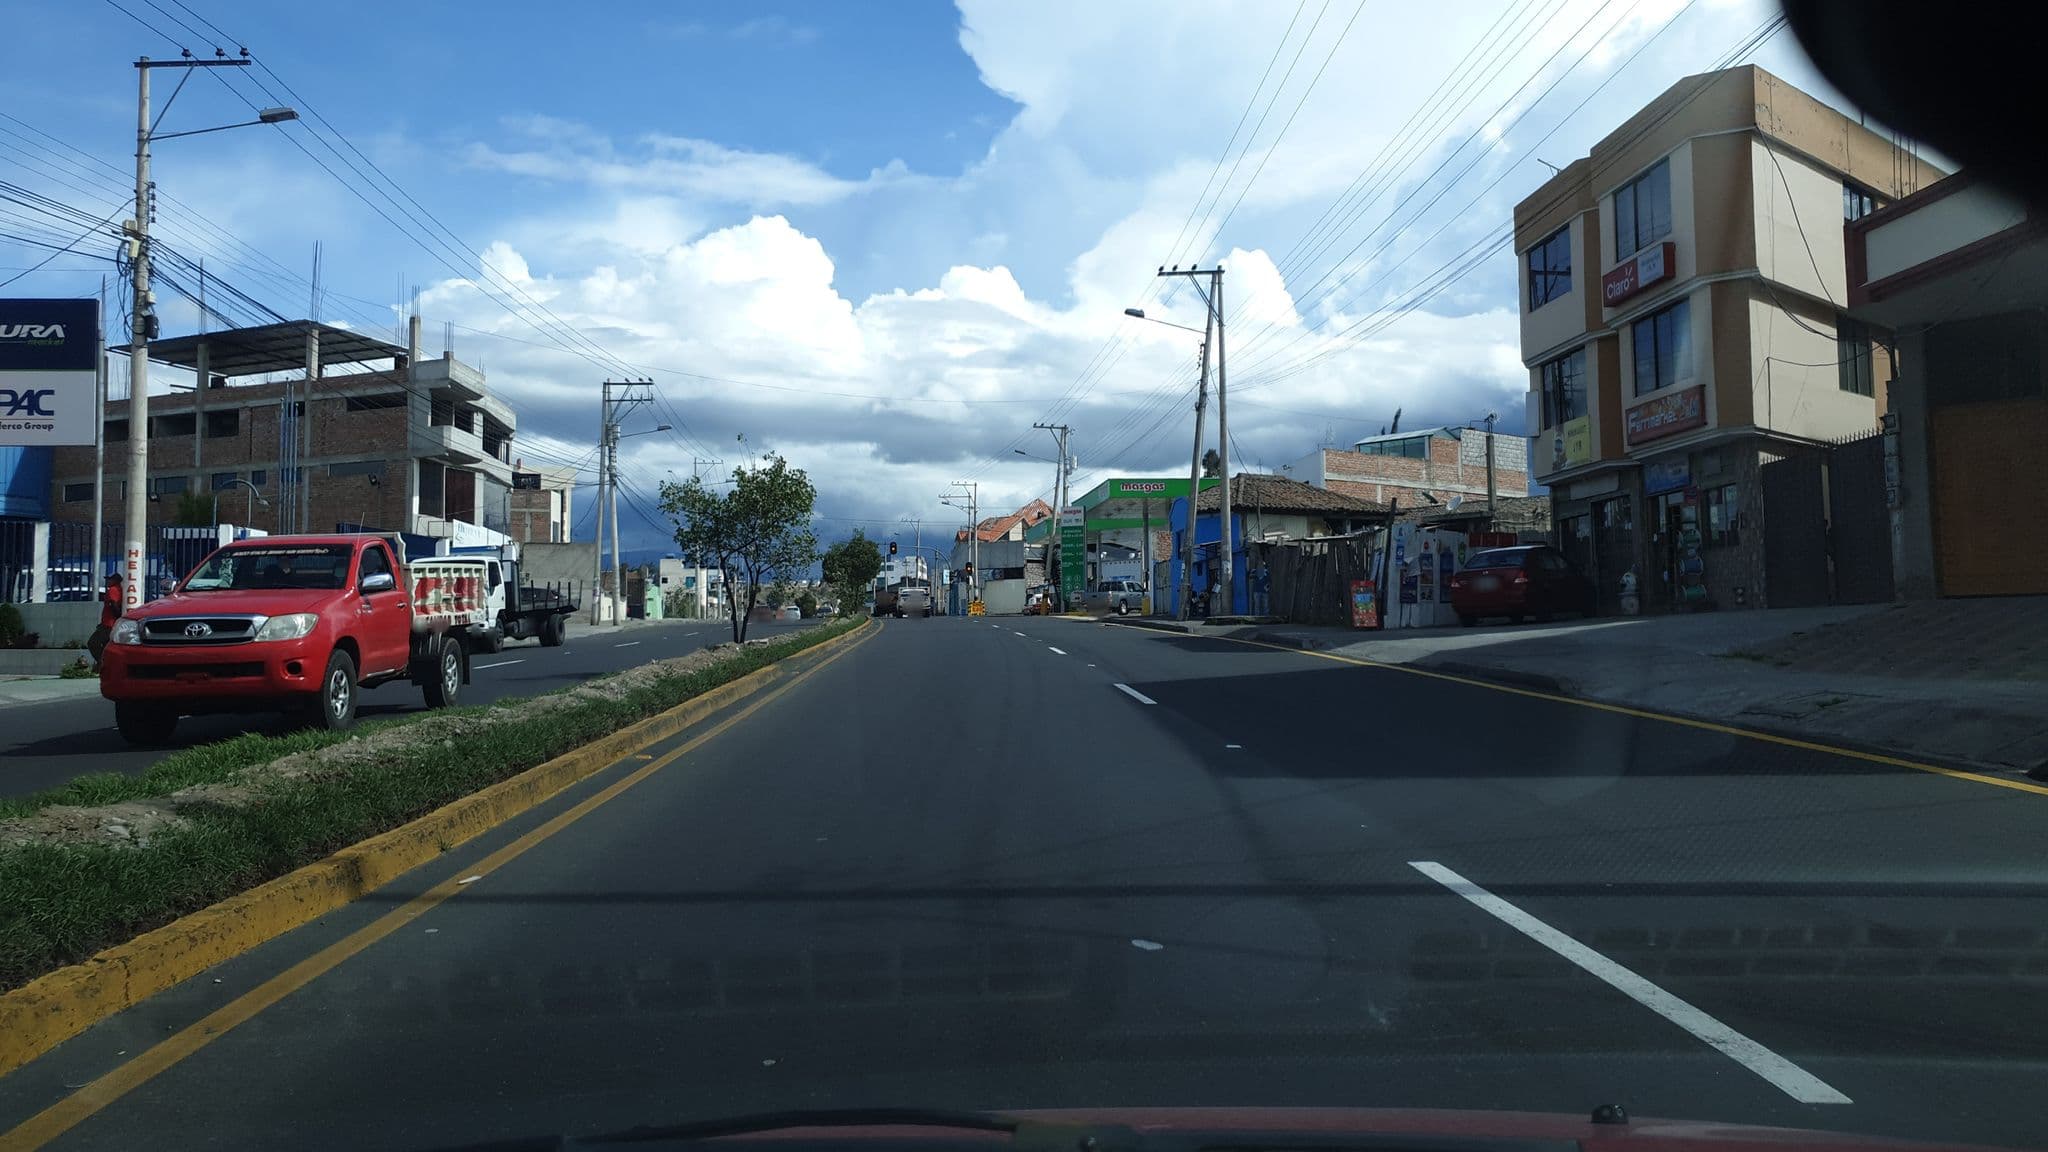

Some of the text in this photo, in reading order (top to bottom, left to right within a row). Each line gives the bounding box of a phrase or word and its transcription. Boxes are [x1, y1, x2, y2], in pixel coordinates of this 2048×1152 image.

[1606, 273, 1630, 299] Claro
[24, 421, 54, 432] Group
[1120, 482, 1165, 494] masgas
